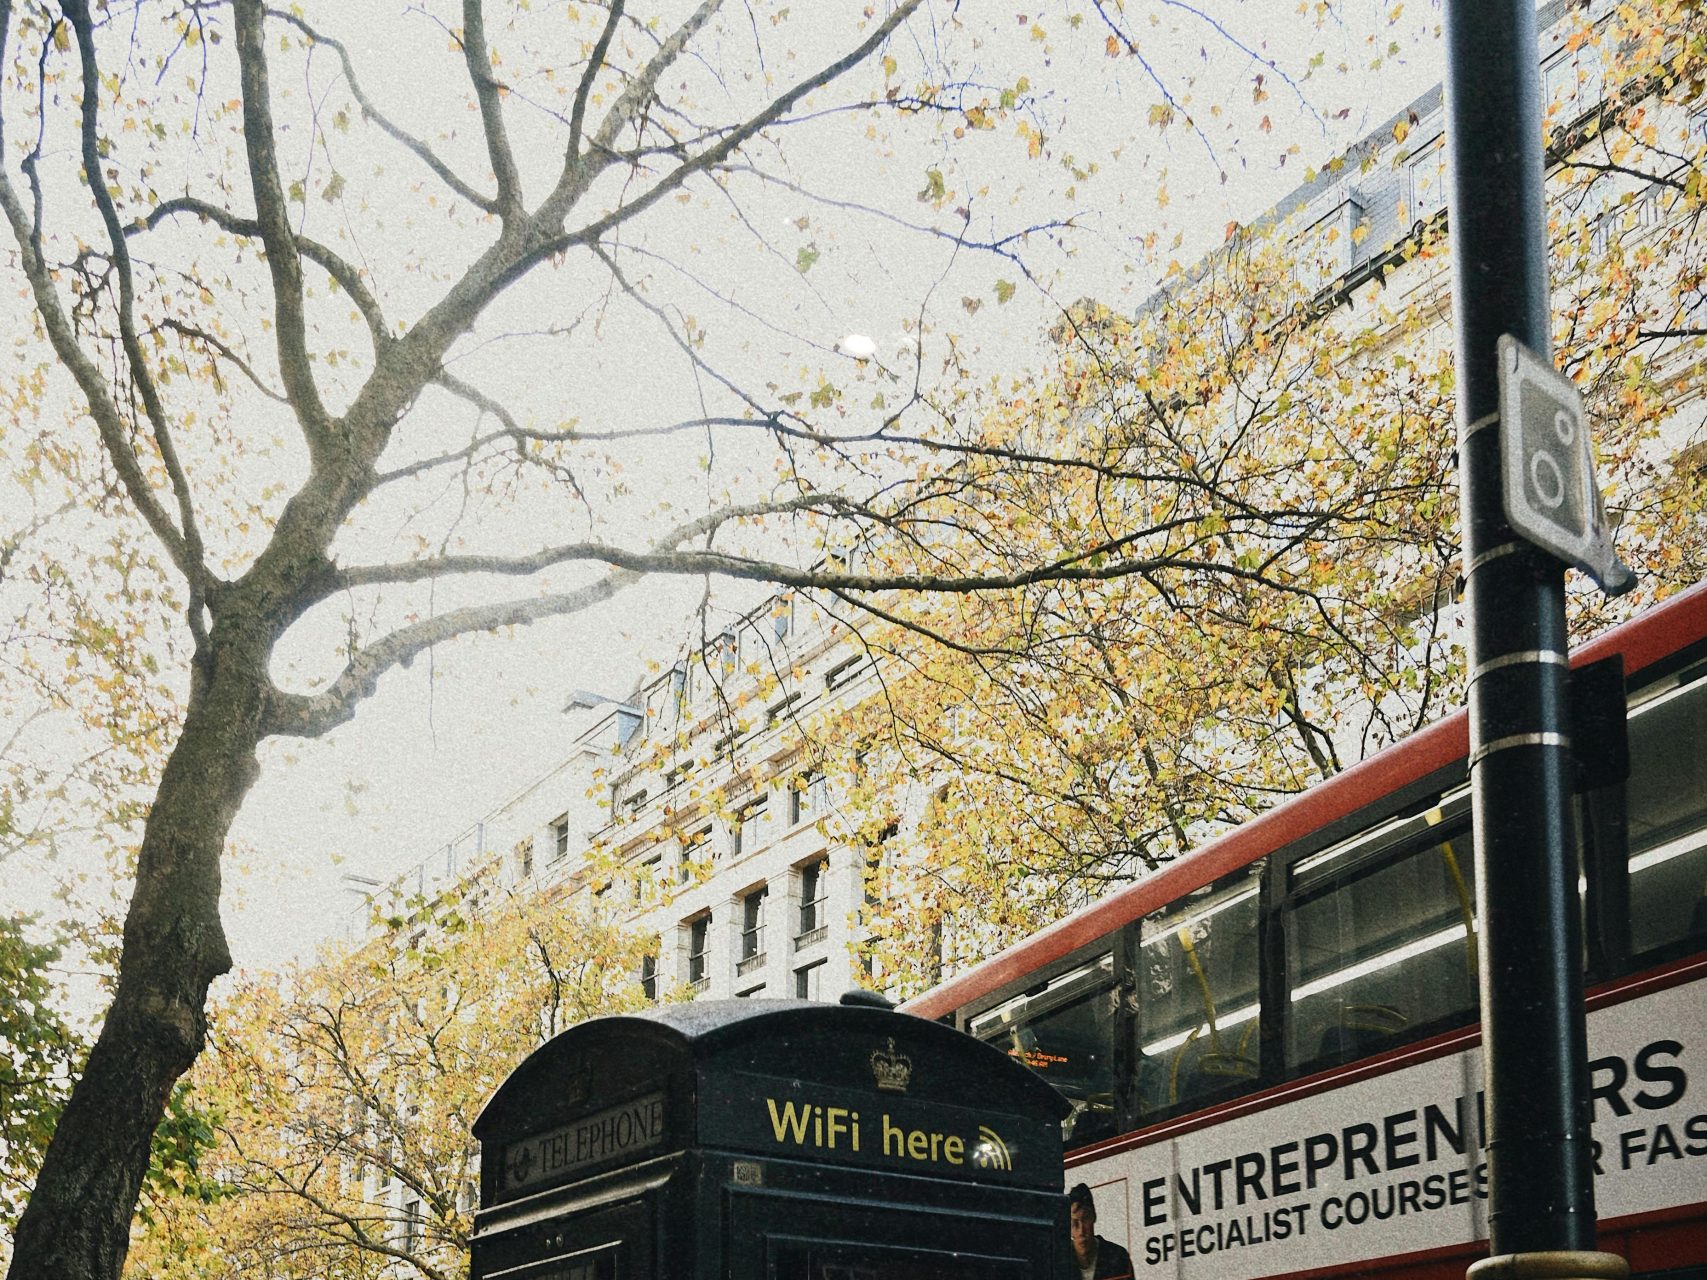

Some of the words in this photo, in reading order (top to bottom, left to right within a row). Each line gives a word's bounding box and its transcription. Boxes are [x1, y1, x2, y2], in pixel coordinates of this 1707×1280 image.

[538, 1100, 664, 1173] TELEPHONE
[766, 1098, 860, 1152] WiFi
[882, 1113, 965, 1165] here
[1142, 1039, 1688, 1228] ENTREPRENRS
[1145, 1203, 1311, 1266] SPECIALIST
